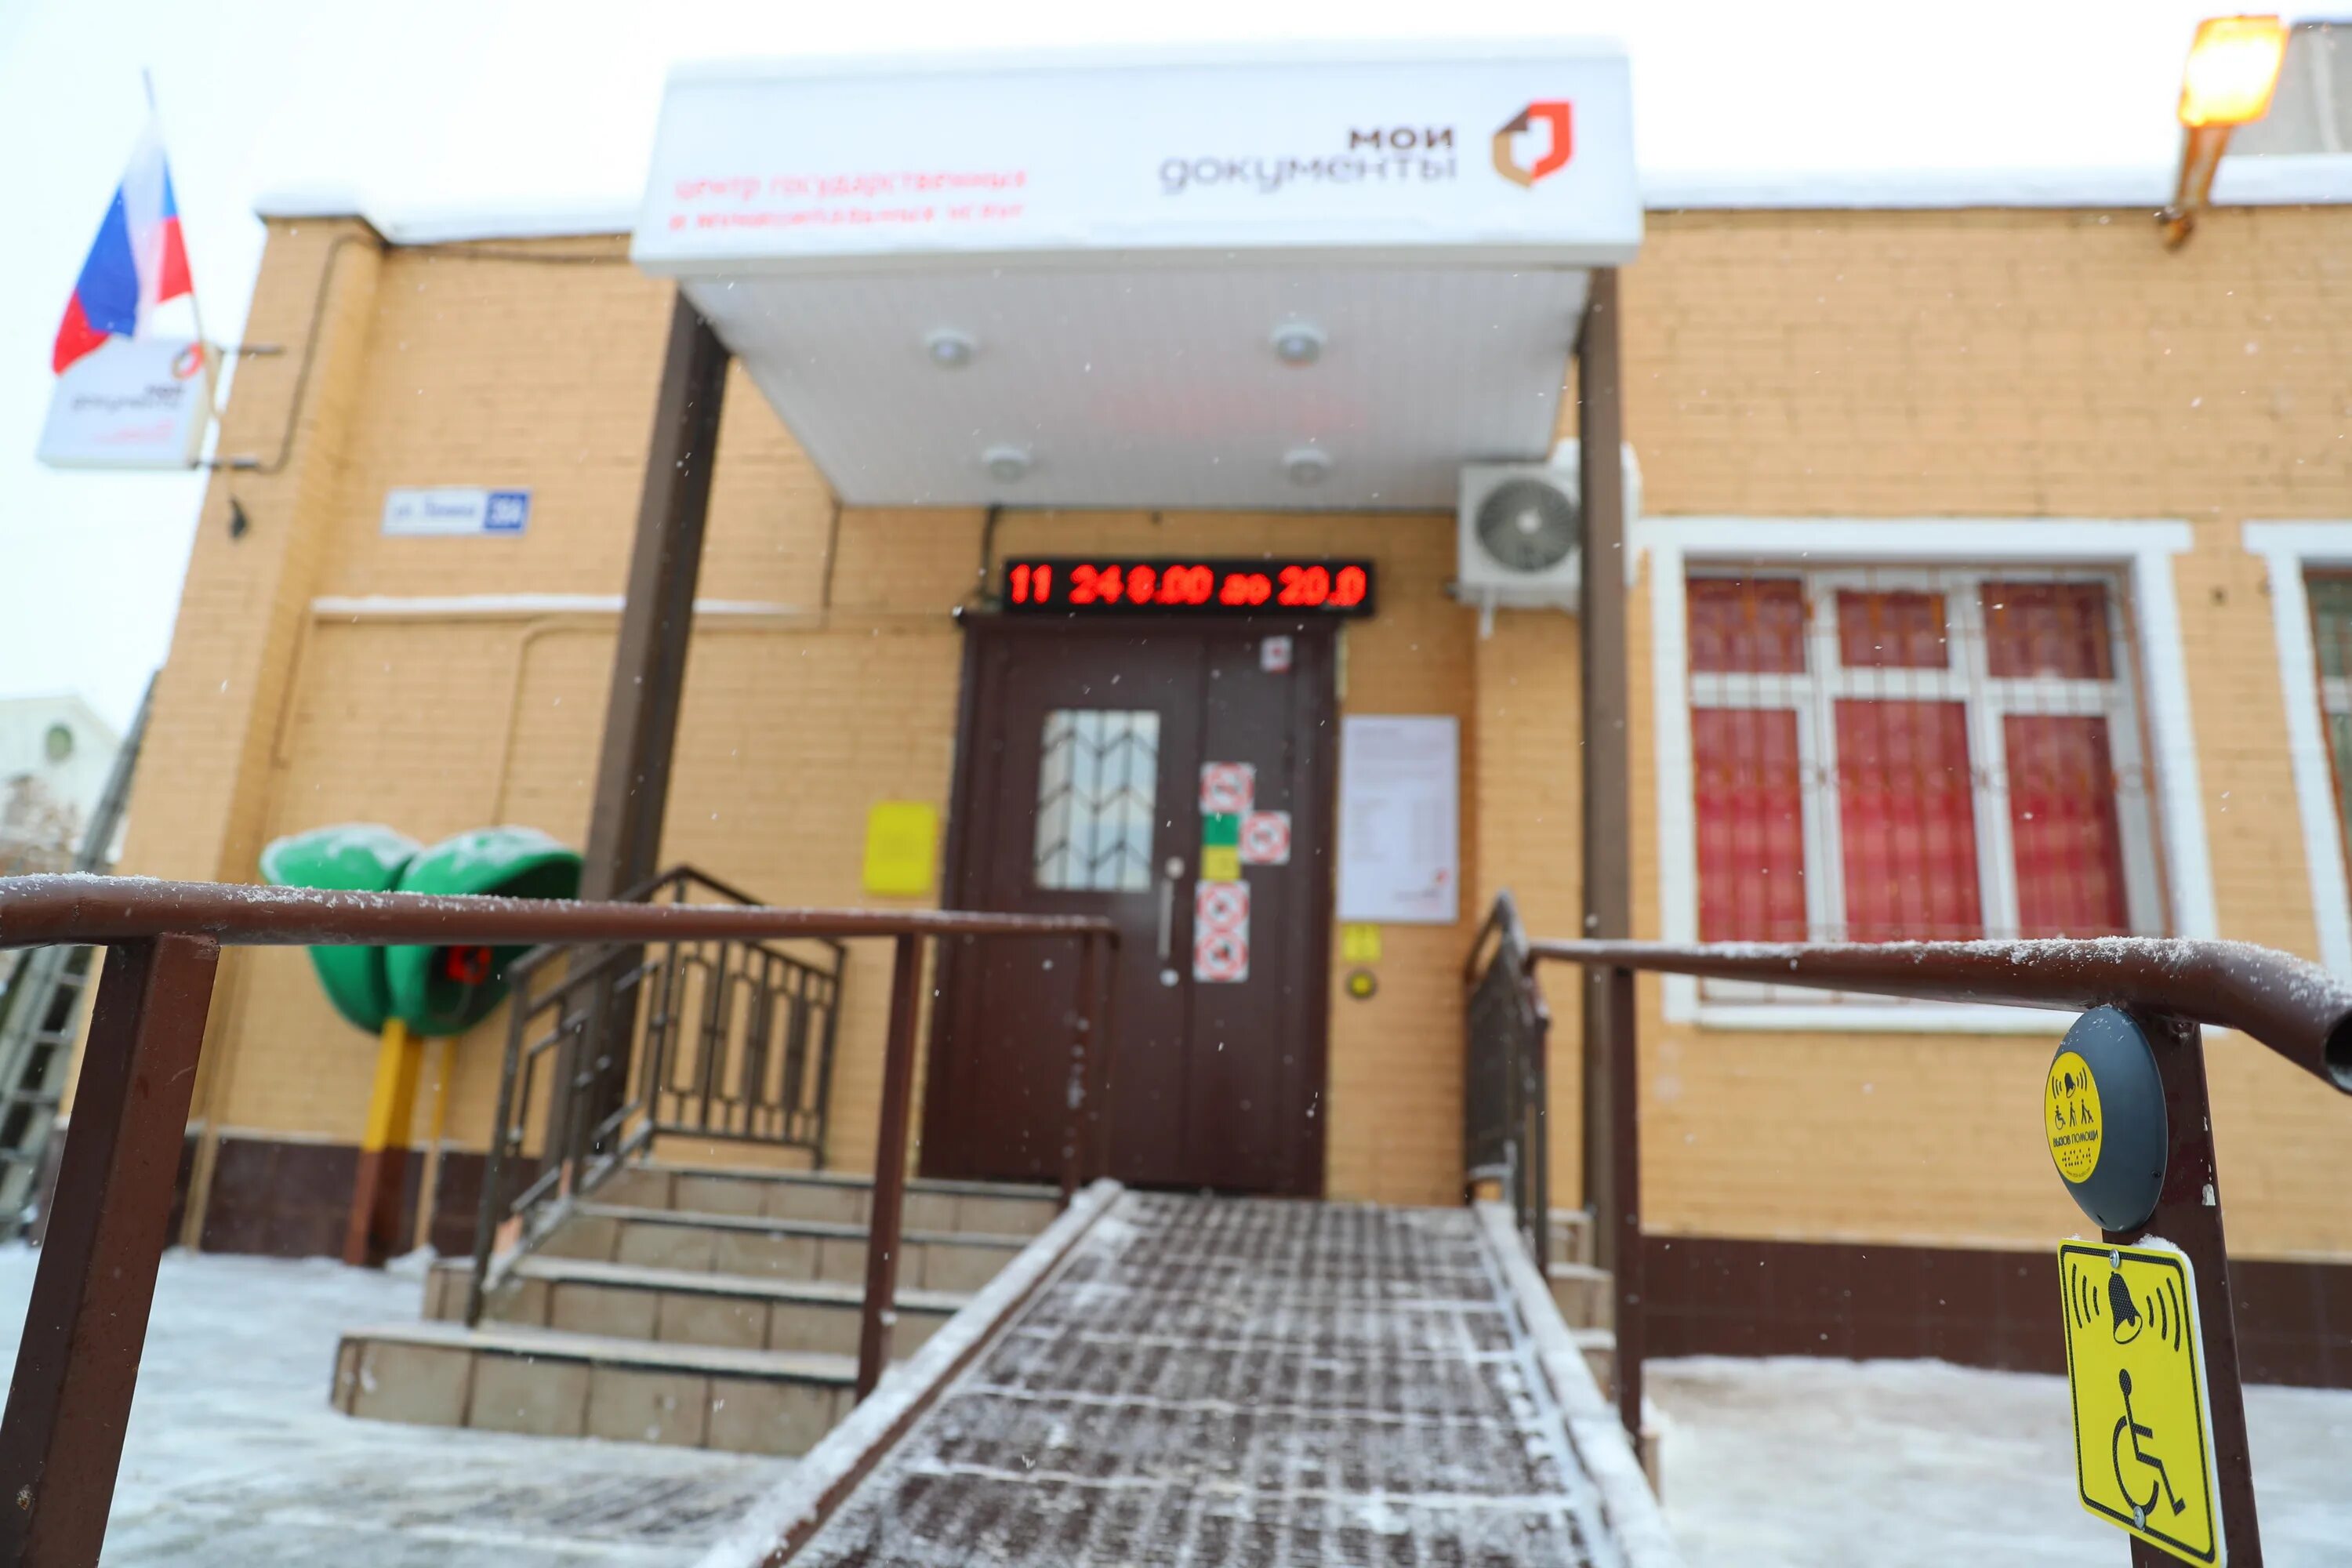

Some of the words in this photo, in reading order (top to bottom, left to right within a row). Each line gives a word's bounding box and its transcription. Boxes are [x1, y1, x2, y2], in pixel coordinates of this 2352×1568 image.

[1159, 153, 1457, 195] документы
[1010, 564, 1052, 603] 11
[2053, 1134, 2071, 1147] ВЫЗОВ
[2071, 1129, 2099, 1144] ПОМОЩИ
